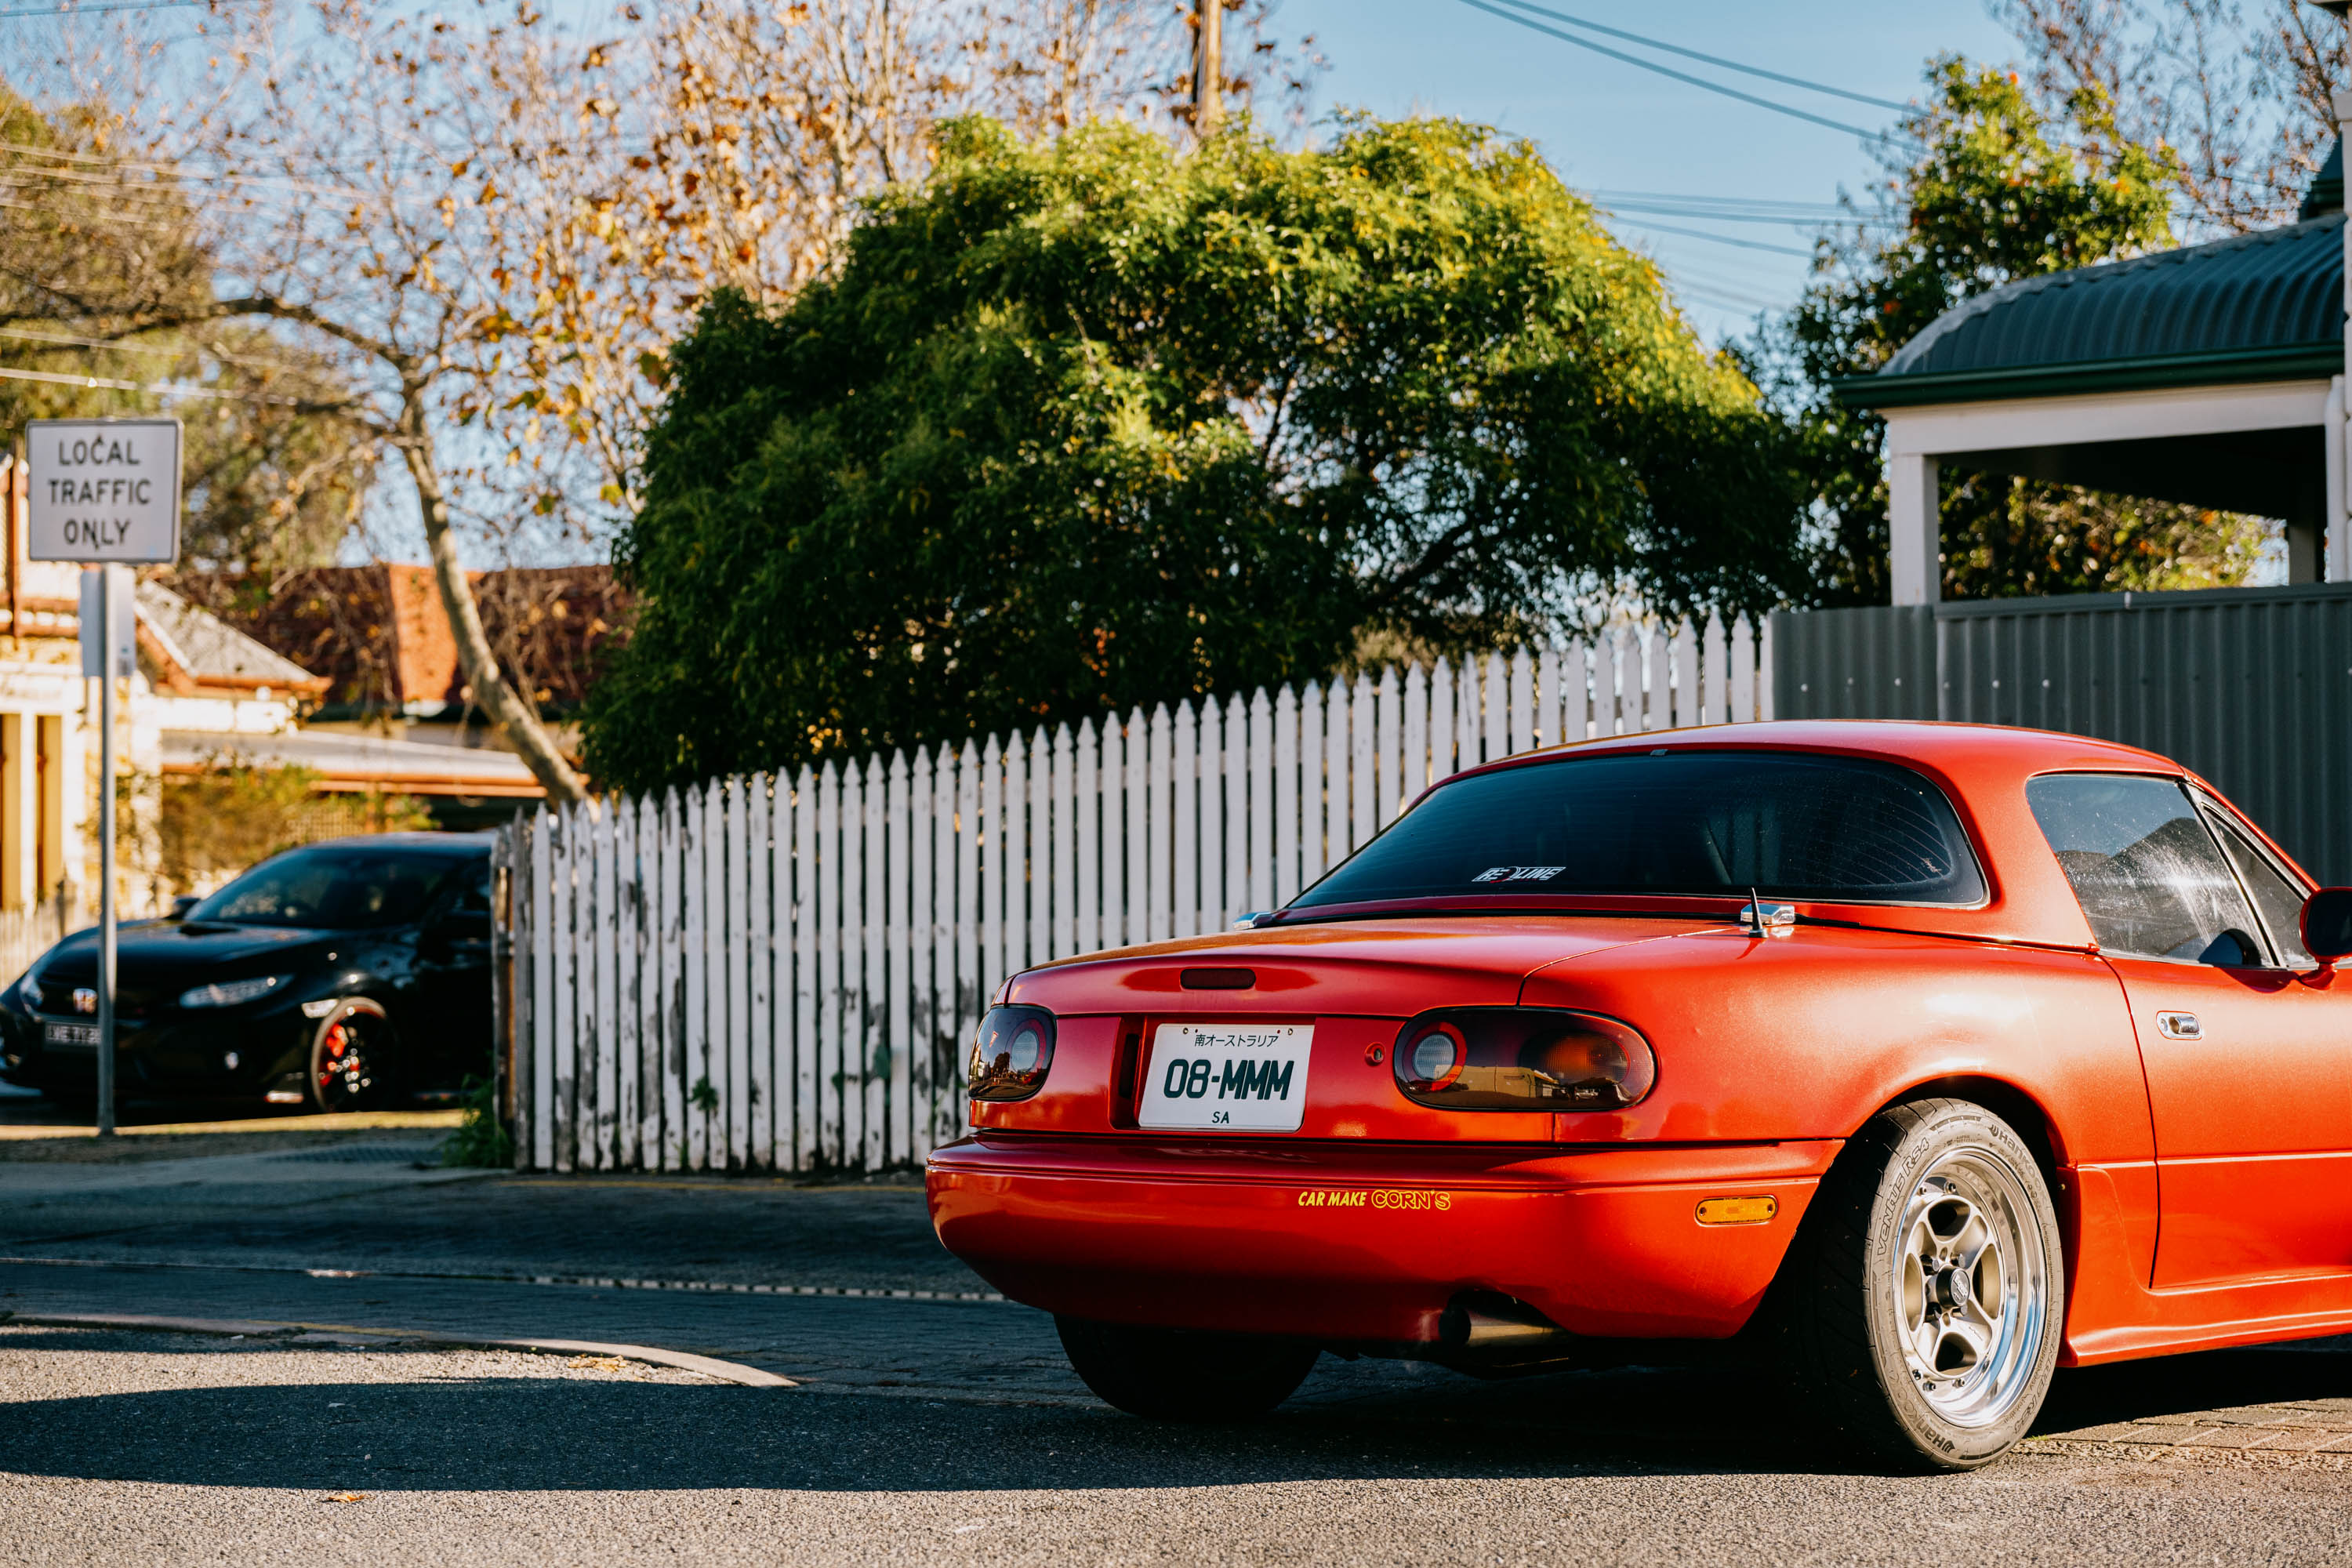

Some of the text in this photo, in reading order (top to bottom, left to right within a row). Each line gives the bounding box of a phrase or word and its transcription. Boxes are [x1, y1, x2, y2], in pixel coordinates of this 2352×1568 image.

[59, 439, 140, 466] LOCAL
[48, 478, 151, 505] TRAFFIC
[64, 518, 131, 546] ONLY
[1194, 1034, 1279, 1047] 南オーストラリア
[1163, 1058, 1294, 1101] 08-MMM
[1211, 1111, 1230, 1124] SA
[1298, 1189, 1451, 1210] CAR MAKE CORN'S
